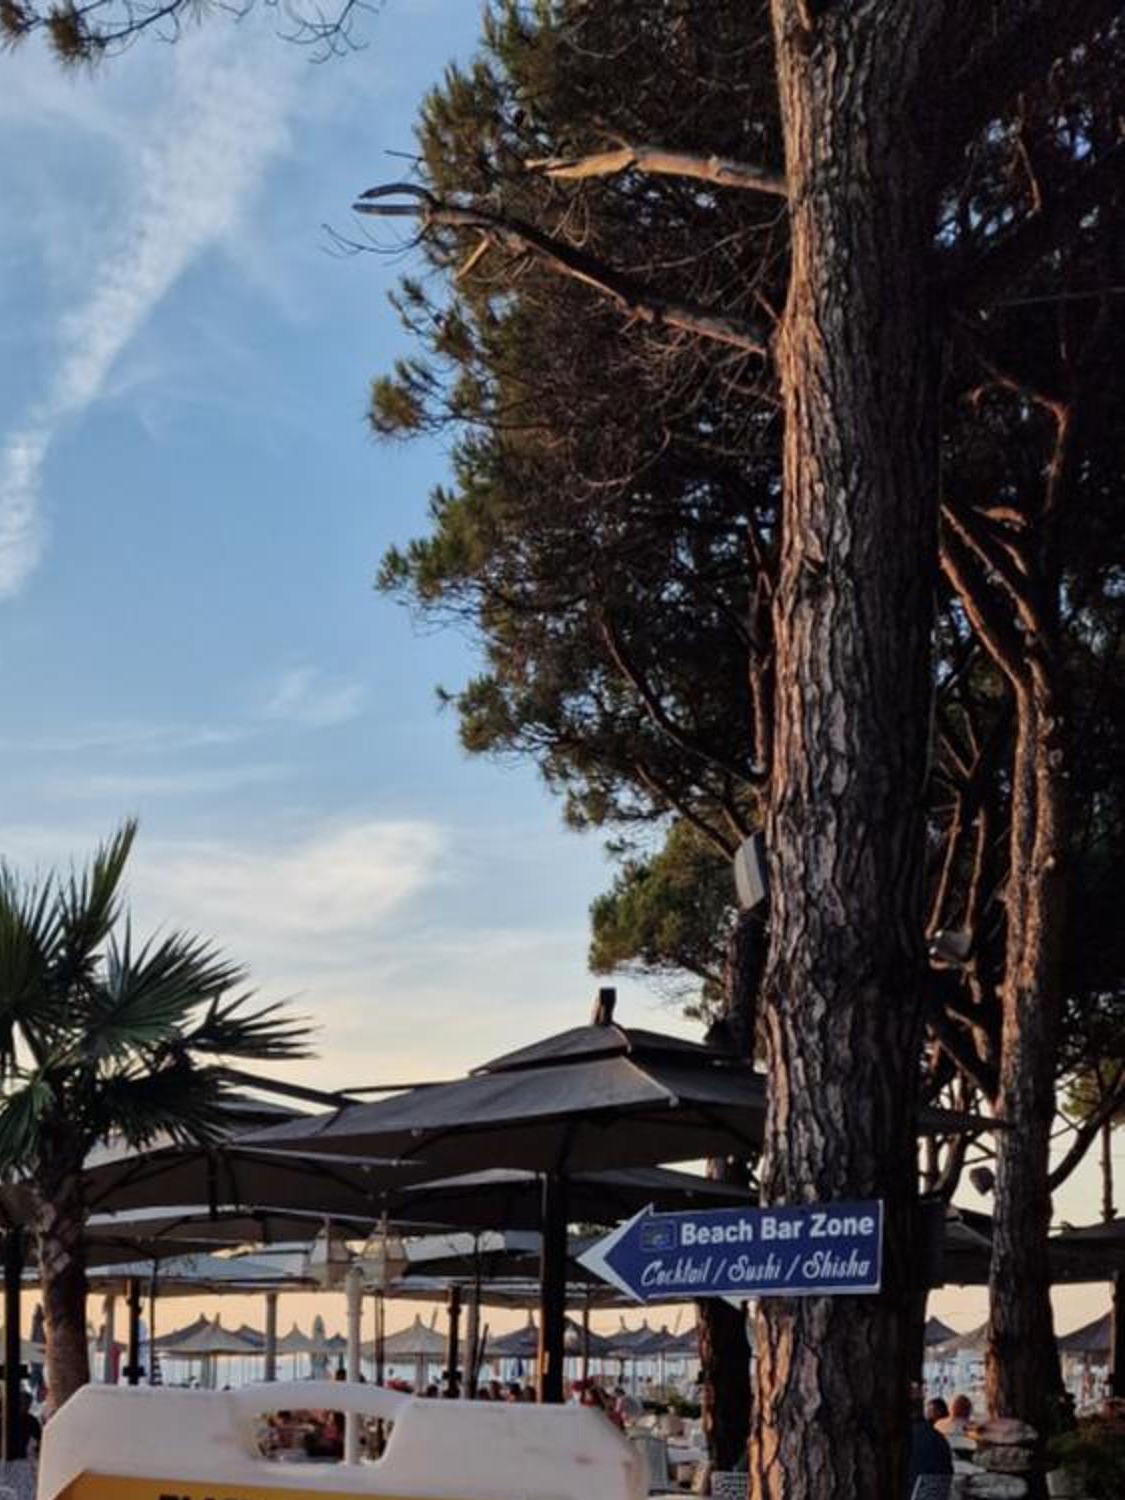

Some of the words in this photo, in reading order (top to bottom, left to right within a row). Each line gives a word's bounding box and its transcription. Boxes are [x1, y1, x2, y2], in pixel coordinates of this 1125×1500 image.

[680, 1220, 753, 1246] Beach
[760, 1217, 803, 1241] Bar
[809, 1213, 875, 1238] Zone
[640, 1257, 712, 1287] Cocktail
[727, 1254, 780, 1282] Sushi
[802, 1250, 871, 1279] Shisha
